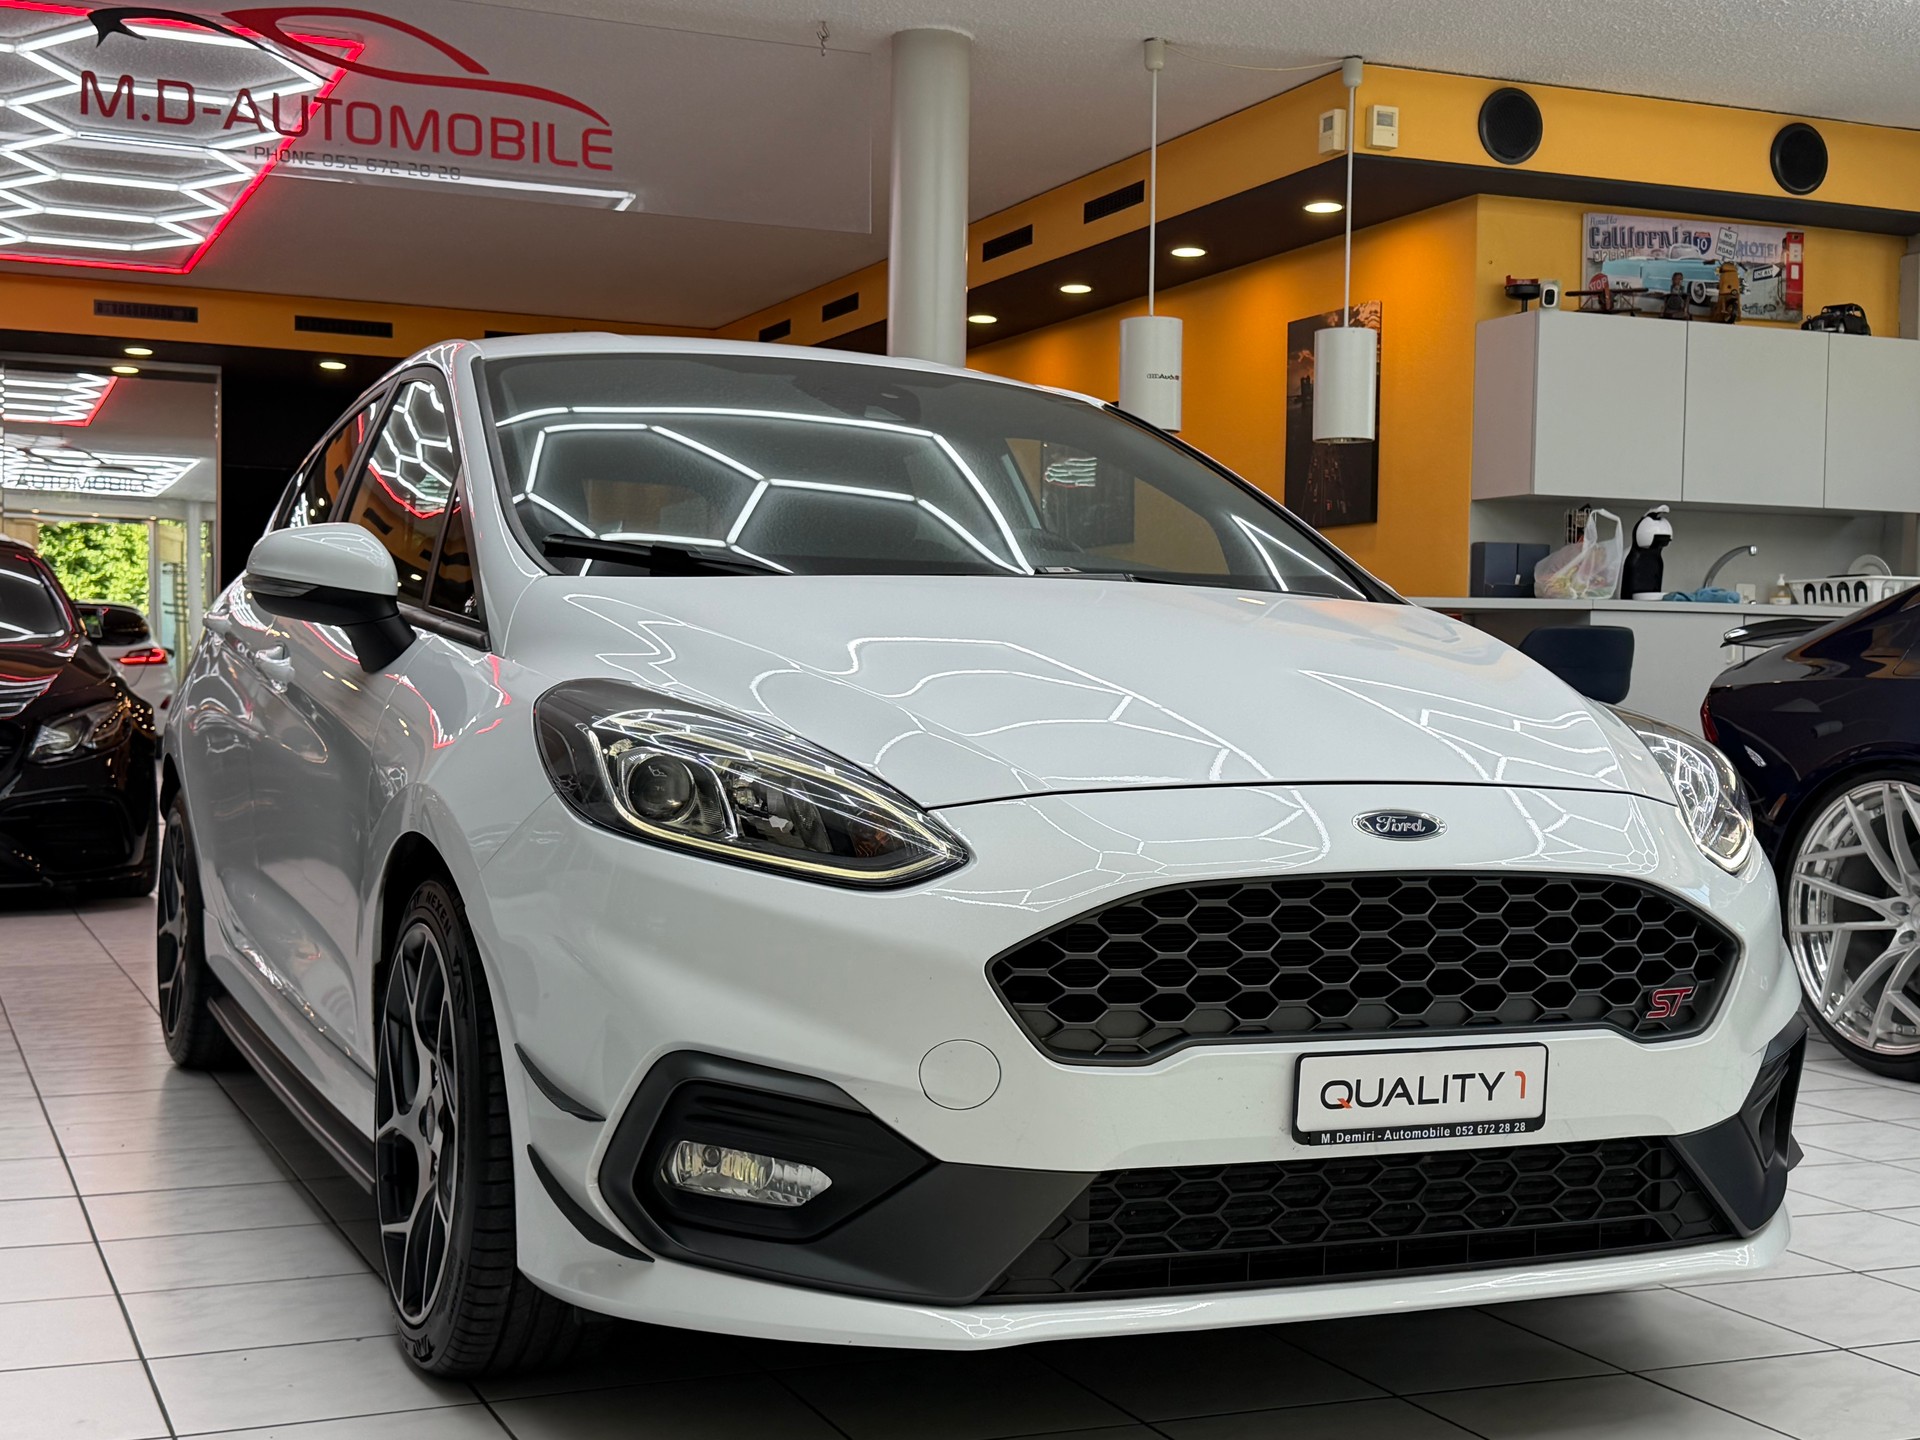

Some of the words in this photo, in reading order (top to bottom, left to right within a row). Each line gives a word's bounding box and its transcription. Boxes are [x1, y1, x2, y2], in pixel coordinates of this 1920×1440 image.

[80, 70, 613, 171] M.D-AUTOMOBILE
[254, 146, 316, 166] PHONE
[322, 153, 359, 171] 052
[366, 158, 400, 175] 672
[1589, 226, 1692, 249] California
[1697, 238, 1708, 251] 10
[1724, 232, 1733, 240] NO
[1718, 246, 1733, 256] ROAD
[1589, 276, 1607, 290] STOP
[1376, 815, 1426, 833] Ford
[426, 890, 452, 937] NEXEN
[1645, 986, 1694, 1019] ST
[1320, 1071, 1506, 1110] QUALITY
[1514, 1070, 1527, 1099] 1
[1383, 1126, 1451, 1141] Automobile
[1455, 1125, 1474, 1136] 052
[1477, 1124, 1495, 1135] 672
[1498, 1122, 1511, 1133] 28
[1514, 1121, 1526, 1132] 28
